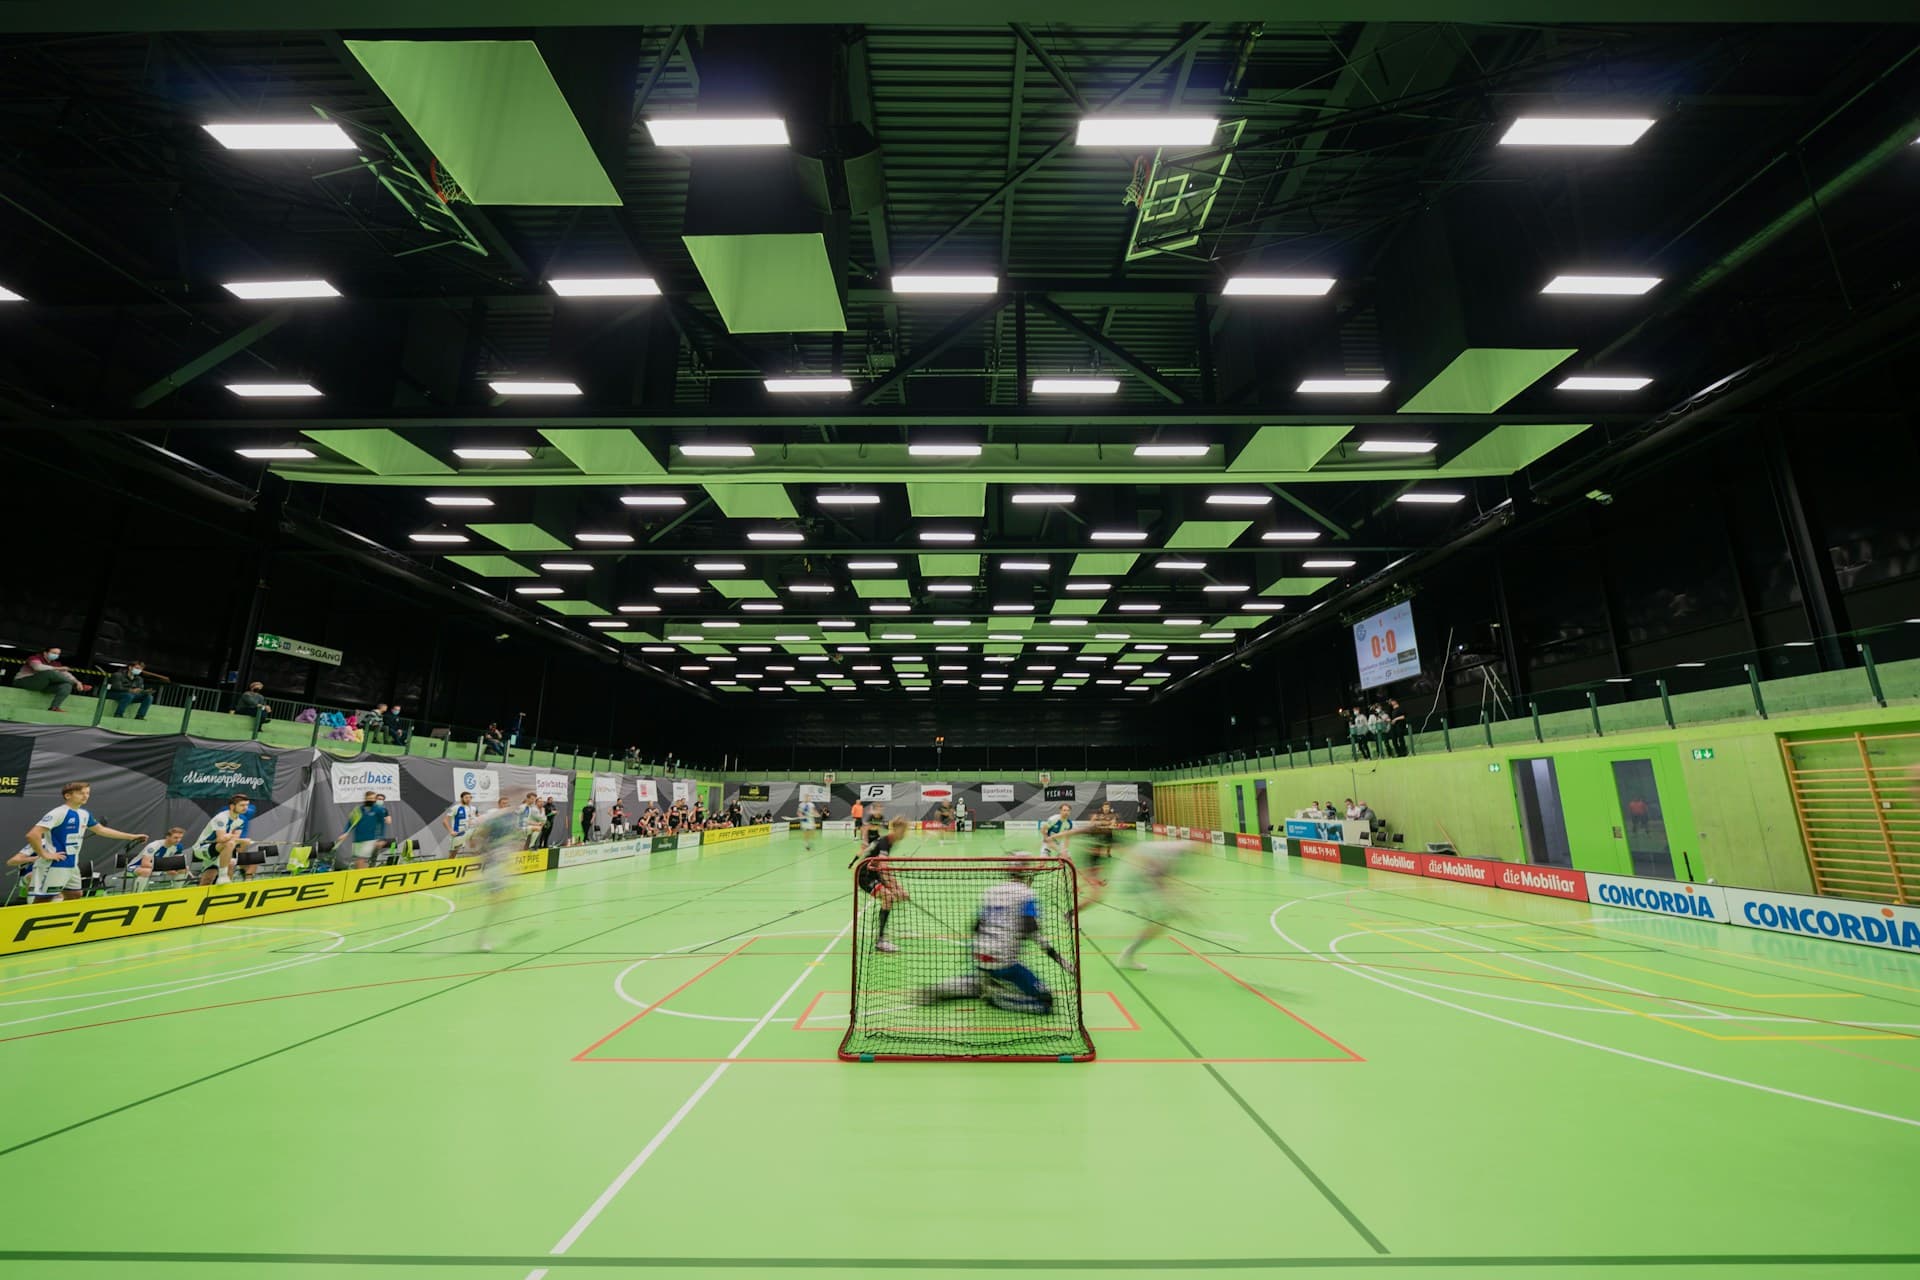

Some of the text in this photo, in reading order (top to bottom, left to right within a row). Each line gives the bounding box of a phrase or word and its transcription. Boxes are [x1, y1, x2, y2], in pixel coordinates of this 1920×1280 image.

[354, 862, 488, 893] FAT PIP
[13, 881, 335, 943] FAT PIPE
[1598, 884, 1715, 919] CONCORDIA
[1743, 901, 1920, 949] CONCORDIA
